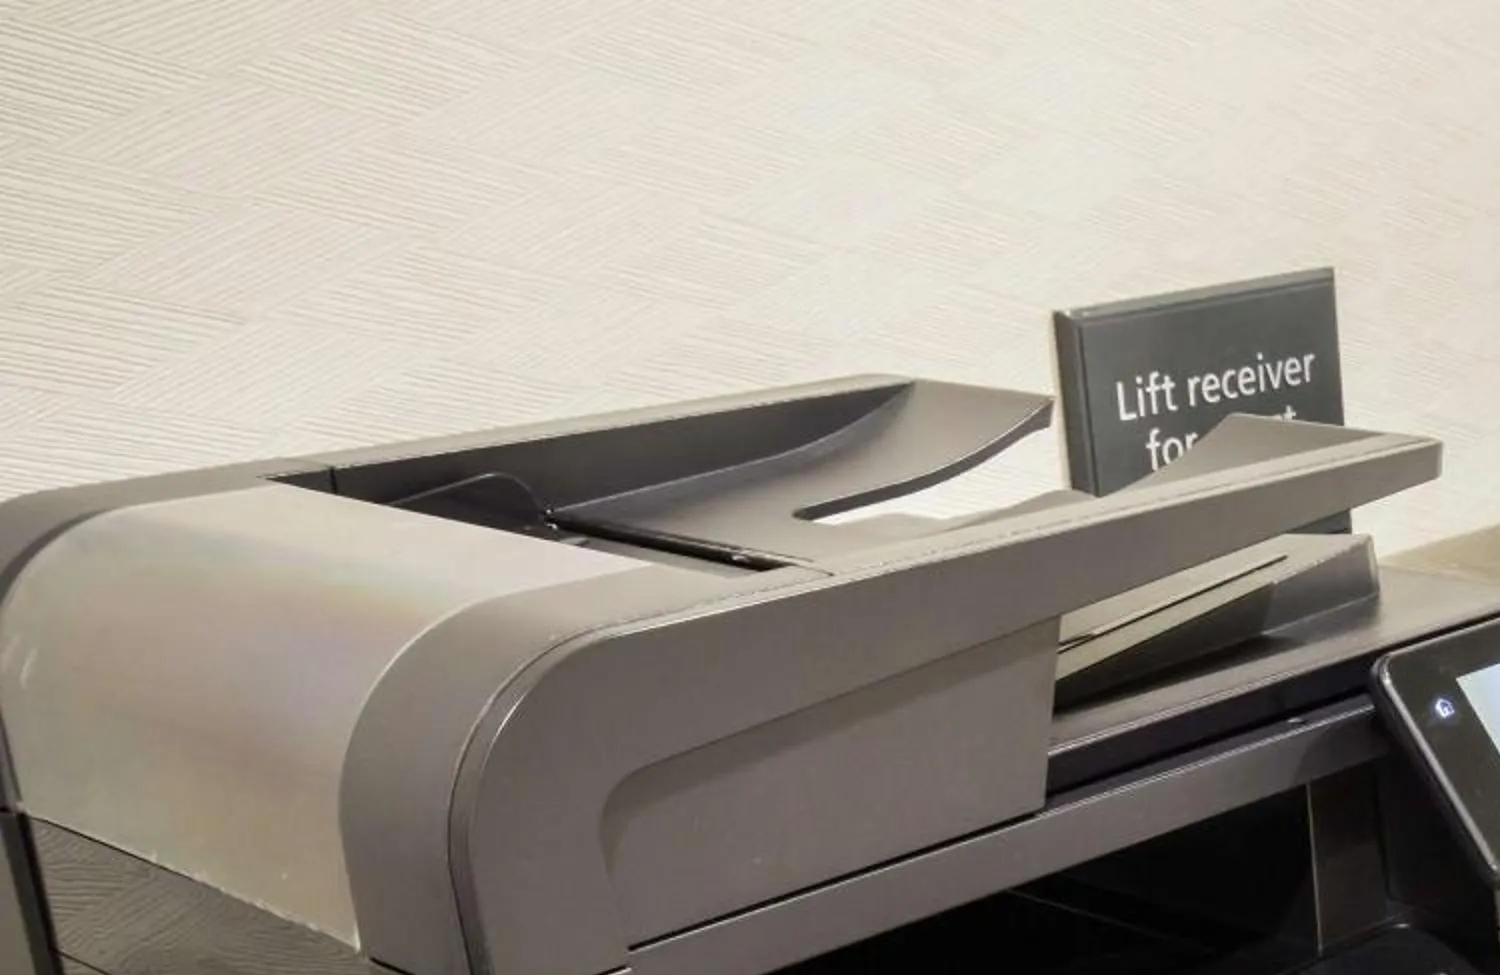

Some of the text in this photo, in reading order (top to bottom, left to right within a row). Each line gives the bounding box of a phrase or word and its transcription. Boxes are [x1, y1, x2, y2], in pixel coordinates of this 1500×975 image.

[1115, 352, 1316, 421] Lift receiver
[1145, 427, 1198, 471] for
